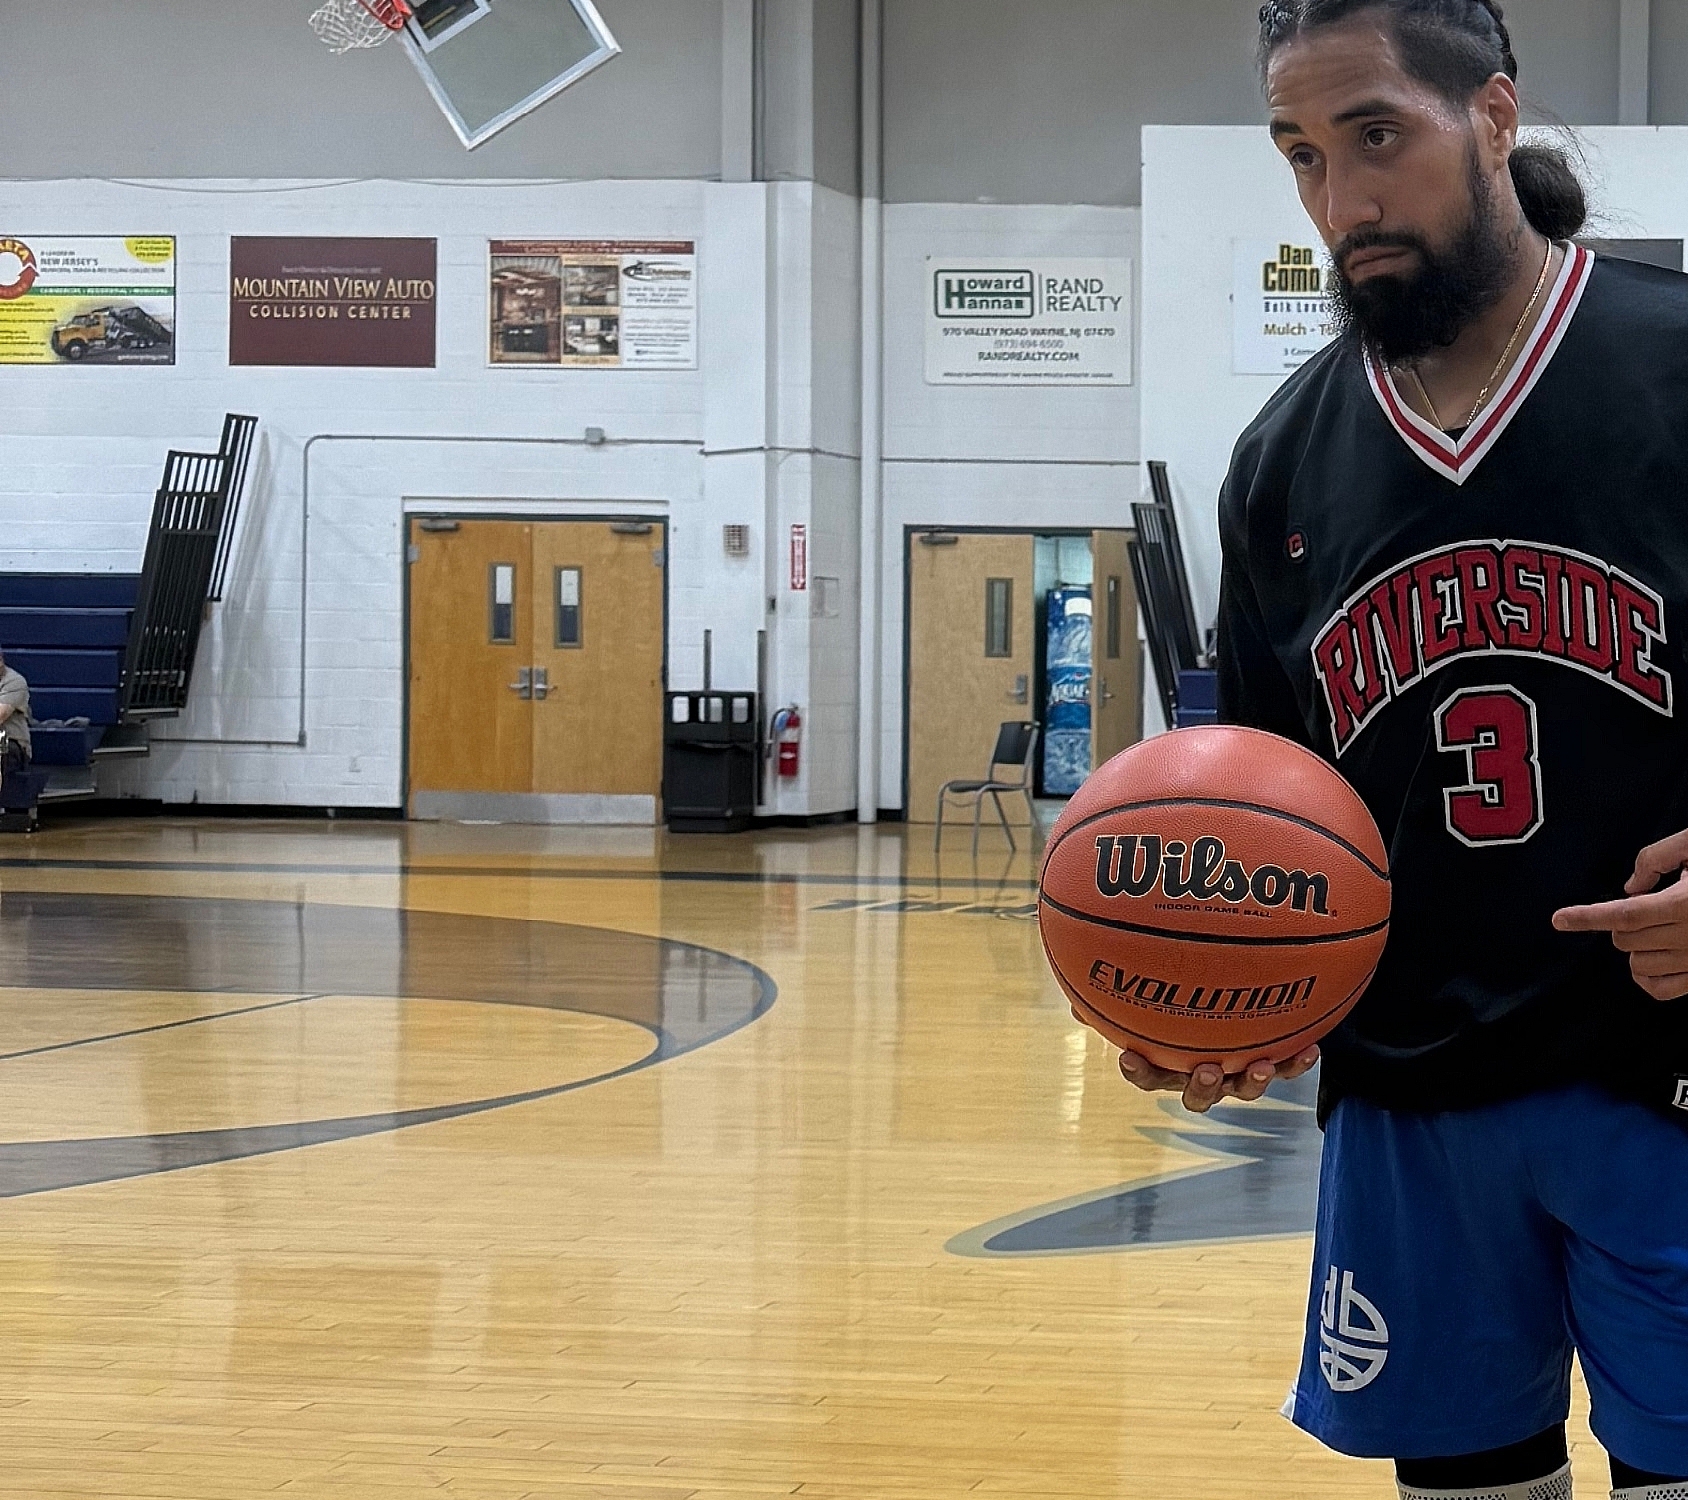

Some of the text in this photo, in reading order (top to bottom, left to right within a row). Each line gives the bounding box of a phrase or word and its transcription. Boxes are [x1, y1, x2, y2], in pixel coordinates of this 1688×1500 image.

[1280, 244, 1313, 265] Dan
[945, 276, 1024, 297] Howard
[1046, 278, 1103, 294] RAND
[1263, 262, 1320, 292] Como
[233, 277, 434, 299] MOUNTAIN VIEW AUTO
[249, 304, 411, 319] COLLISION CENTER
[1046, 296, 1122, 312] REALTY
[1263, 323, 1307, 336] Mulch
[1310, 539, 1673, 759] RIVERSIDE
[1433, 684, 1544, 847] 3
[1094, 834, 1331, 917] Wilson
[1088, 959, 1317, 1012] EVOLUTION
